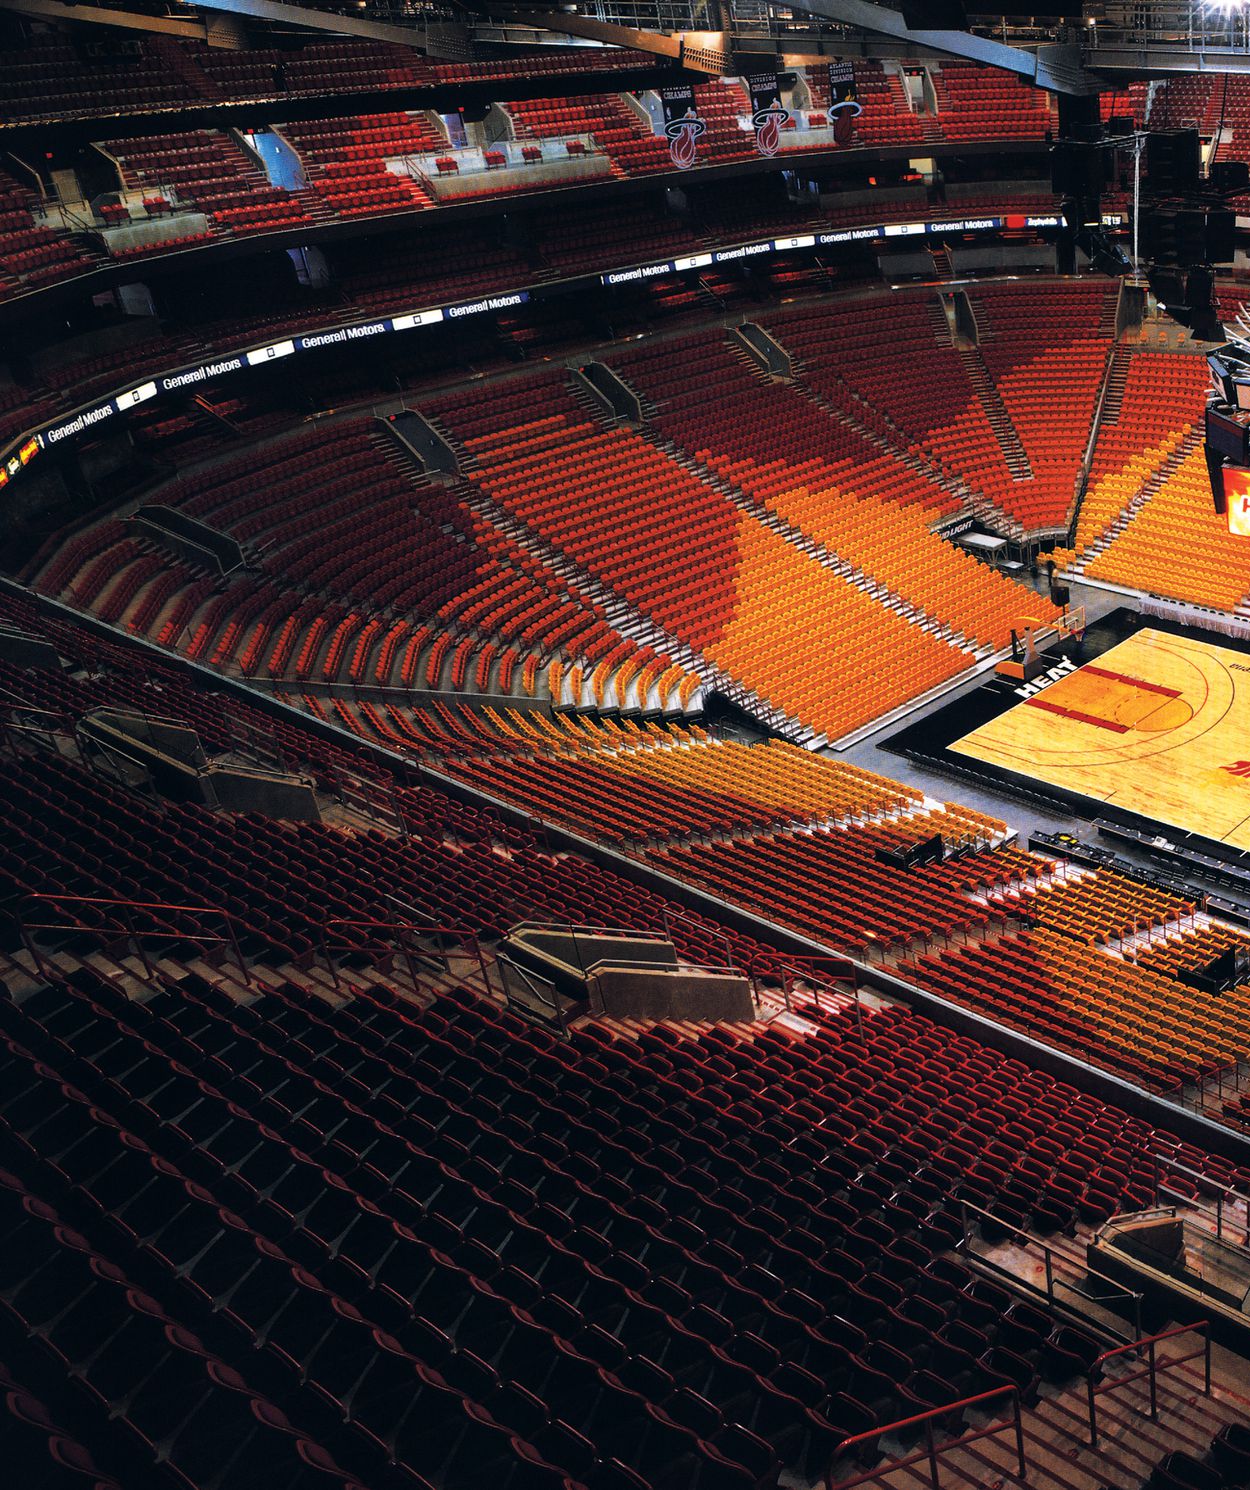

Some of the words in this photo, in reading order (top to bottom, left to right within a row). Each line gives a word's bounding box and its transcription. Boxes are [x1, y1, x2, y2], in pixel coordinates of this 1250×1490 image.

[820, 232, 851, 243] General
[852, 228, 879, 239] Motors
[931, 221, 964, 232] General
[964, 218, 994, 230] Motors
[717, 248, 745, 261] General
[746, 243, 770, 255] Motors
[609, 269, 641, 284] General
[642, 264, 670, 277] Motors
[449, 300, 488, 318] General
[489, 294, 521, 309] Motors
[302, 330, 347, 349] General
[348, 323, 385, 339] Motors
[163, 367, 206, 390] General
[206, 358, 241, 378] Motors
[48, 416, 84, 443] General
[84, 404, 113, 426] Motors
[950, 520, 973, 536] LIGHT
[1014, 654, 1078, 698] HEAT
